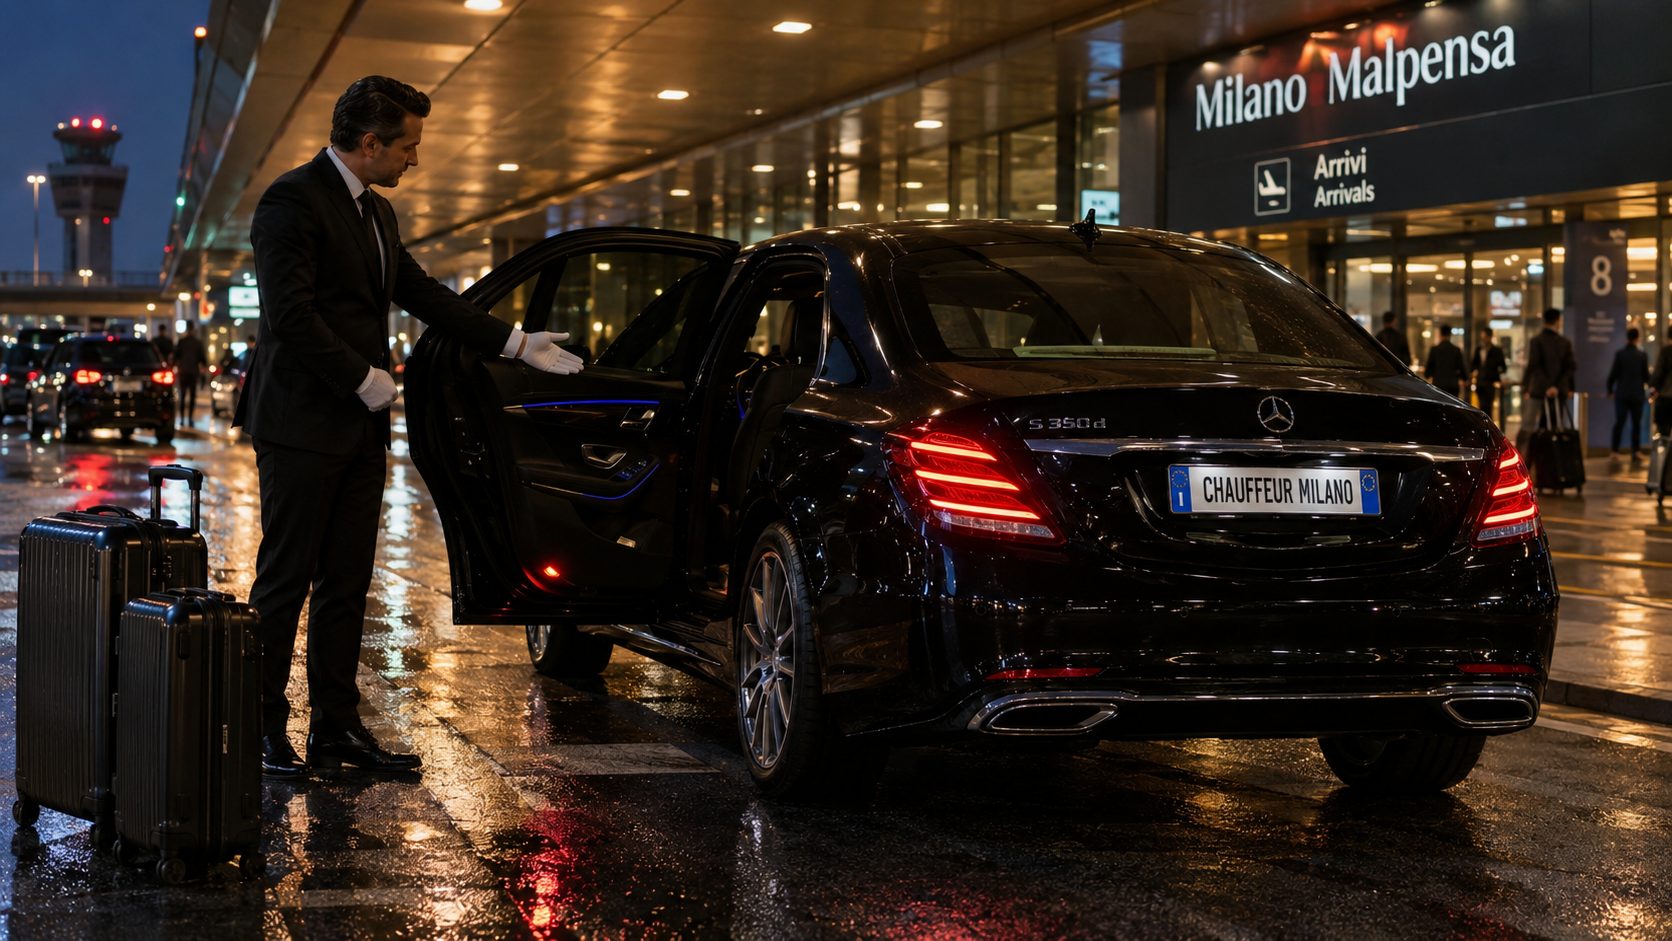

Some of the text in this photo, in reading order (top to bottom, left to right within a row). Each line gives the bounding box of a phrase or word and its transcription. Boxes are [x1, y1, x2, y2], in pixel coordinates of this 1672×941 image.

[1196, 25, 1516, 131] Milano Malpensa
[1314, 147, 1368, 180] Arrivi
[1314, 180, 1376, 207] Arrivals
[1590, 255, 1613, 296] 8
[1029, 417, 1106, 430] S 350 d
[1178, 491, 1184, 507] I
[1203, 476, 1354, 505] CHAUFFEUR MILANO
